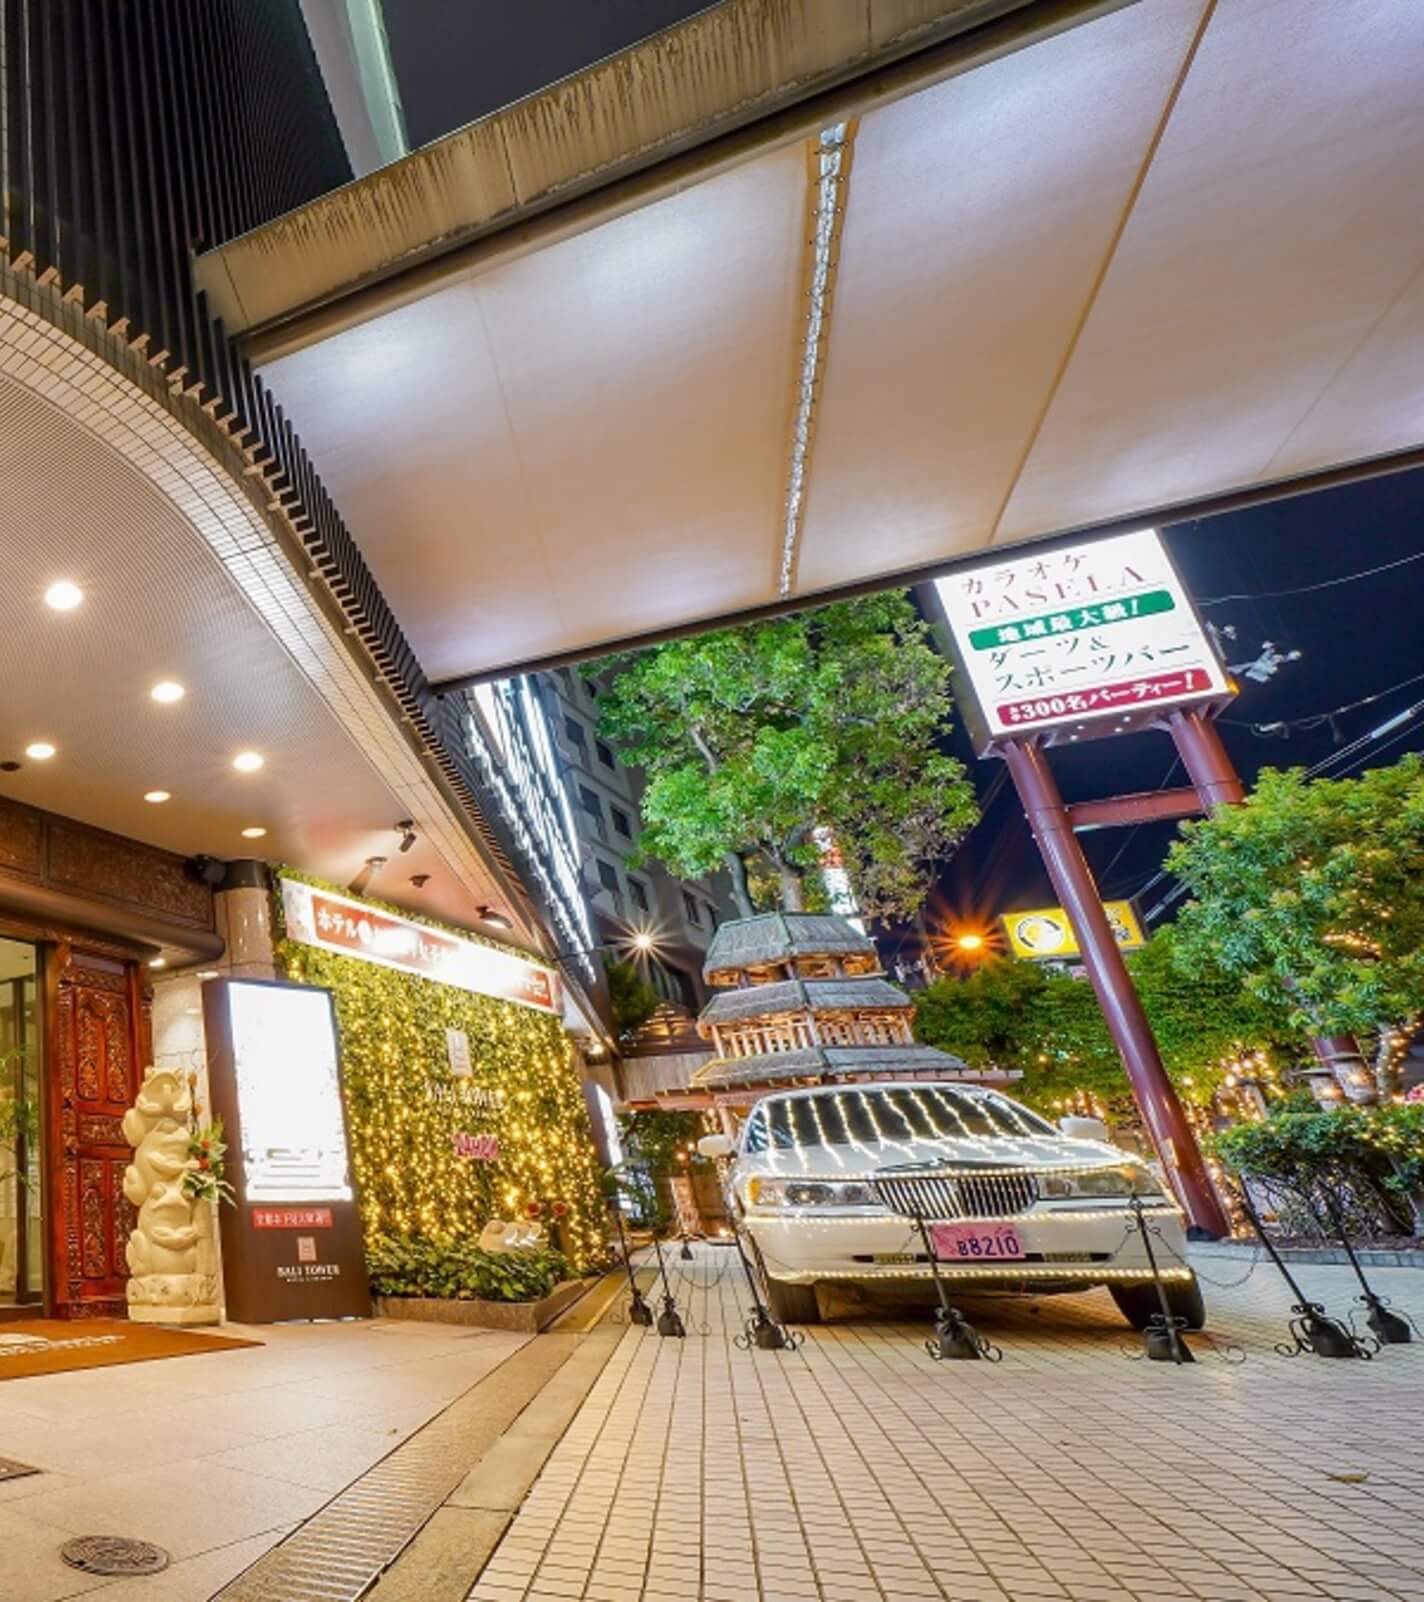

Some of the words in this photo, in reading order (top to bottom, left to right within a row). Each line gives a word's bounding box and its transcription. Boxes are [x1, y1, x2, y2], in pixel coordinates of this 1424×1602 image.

[962, 554, 1088, 595] カラオケ
[971, 565, 1145, 618] PASELA
